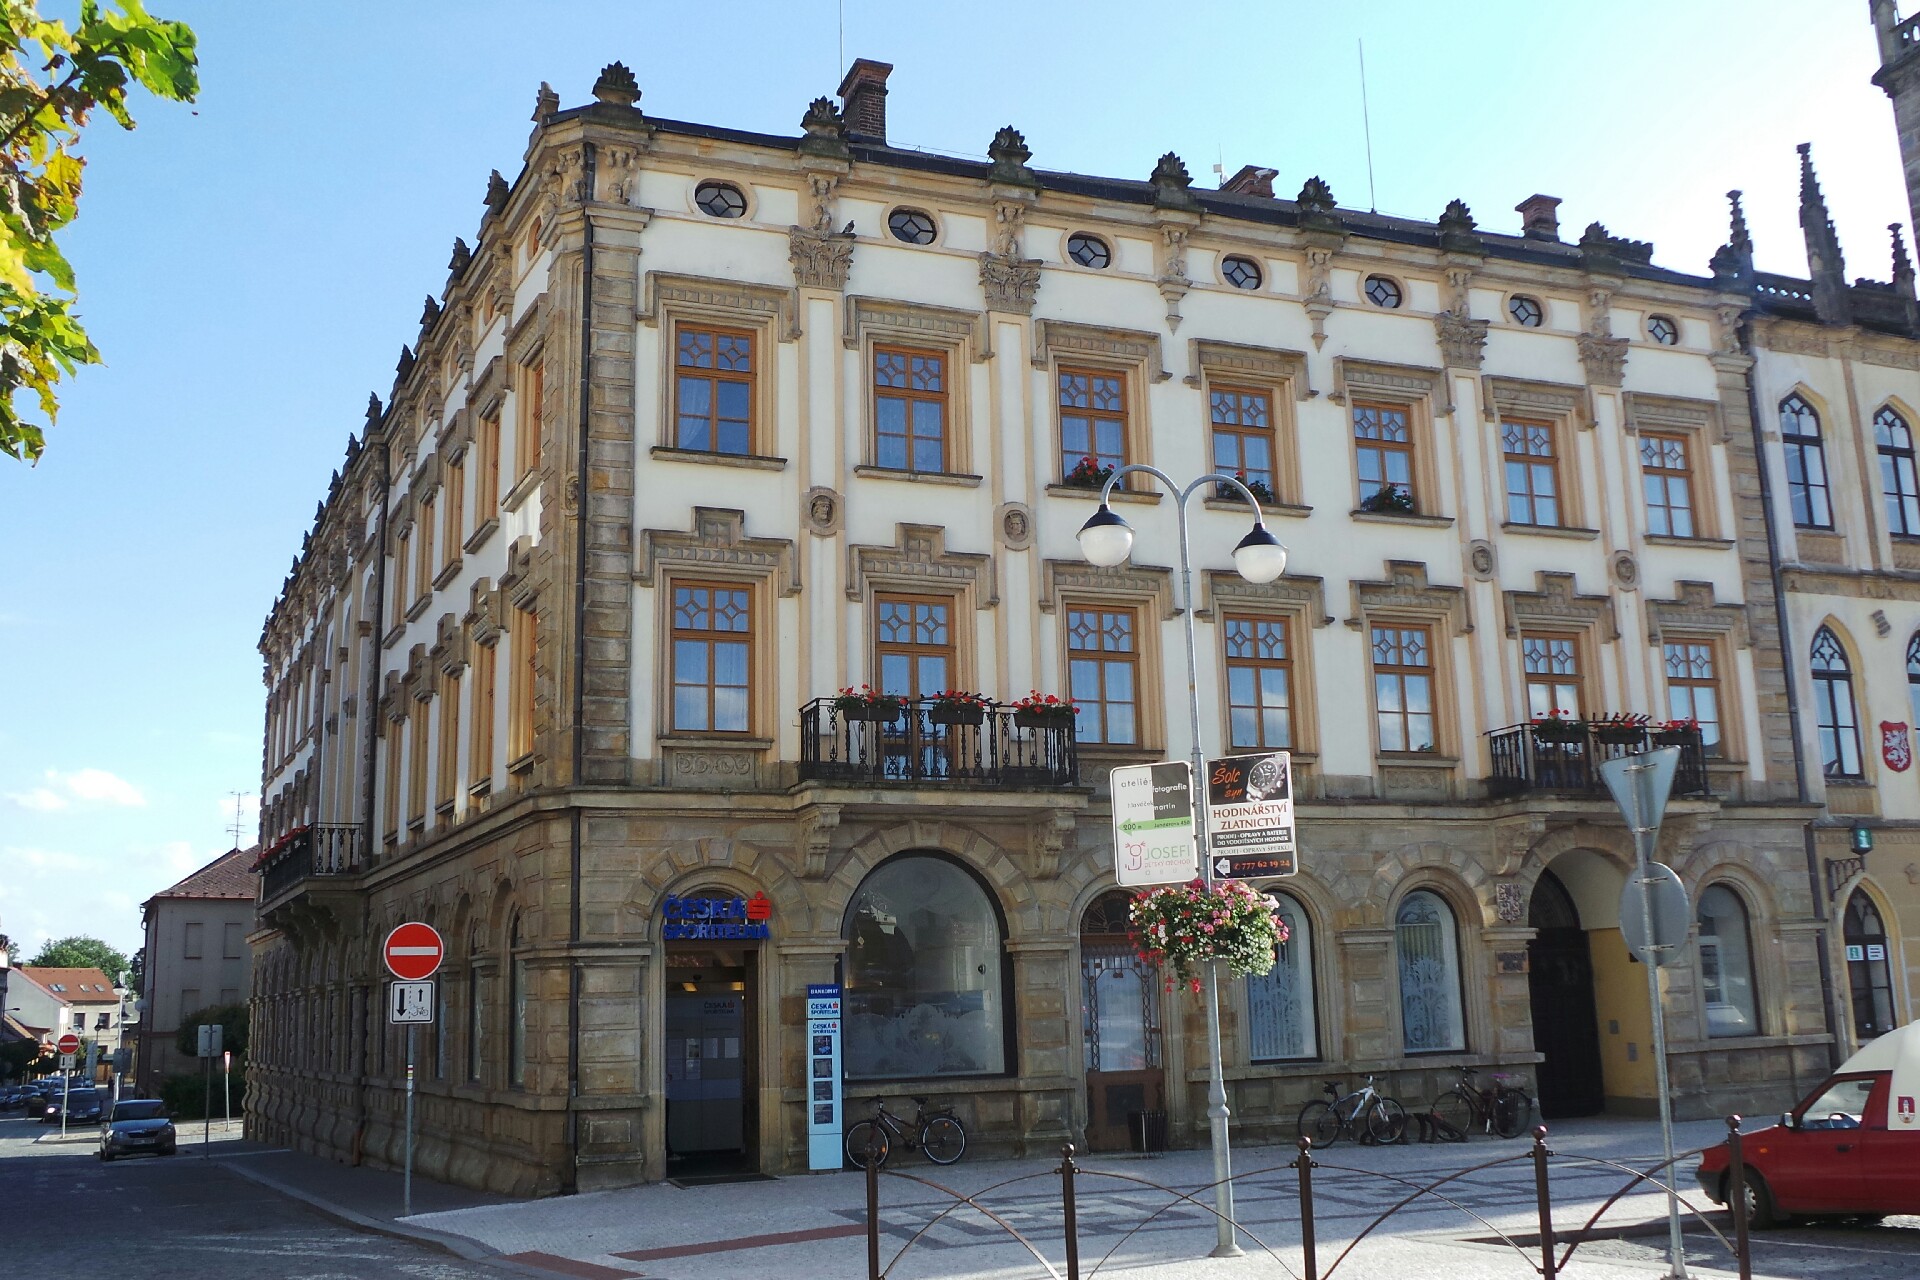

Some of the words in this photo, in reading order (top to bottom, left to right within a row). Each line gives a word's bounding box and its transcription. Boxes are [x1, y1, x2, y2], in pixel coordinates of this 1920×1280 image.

[1212, 763, 1240, 785] Šolc
[1121, 778, 1152, 788] ateliér
[1152, 783, 1187, 794] fotografie
[1225, 788, 1243, 800] syn
[1154, 803, 1176, 811] martin
[1213, 801, 1287, 818] HODINÁŘSTVÍ
[1221, 814, 1281, 830] ZLATNICTVÍ
[1216, 832, 1237, 840] PRODEJ
[1145, 845, 1190, 860] JOSEFI
[1242, 862, 1256, 871] 777
[662, 893, 746, 919] ČESKÁ
[663, 920, 770, 940] SPOŘITELNA
